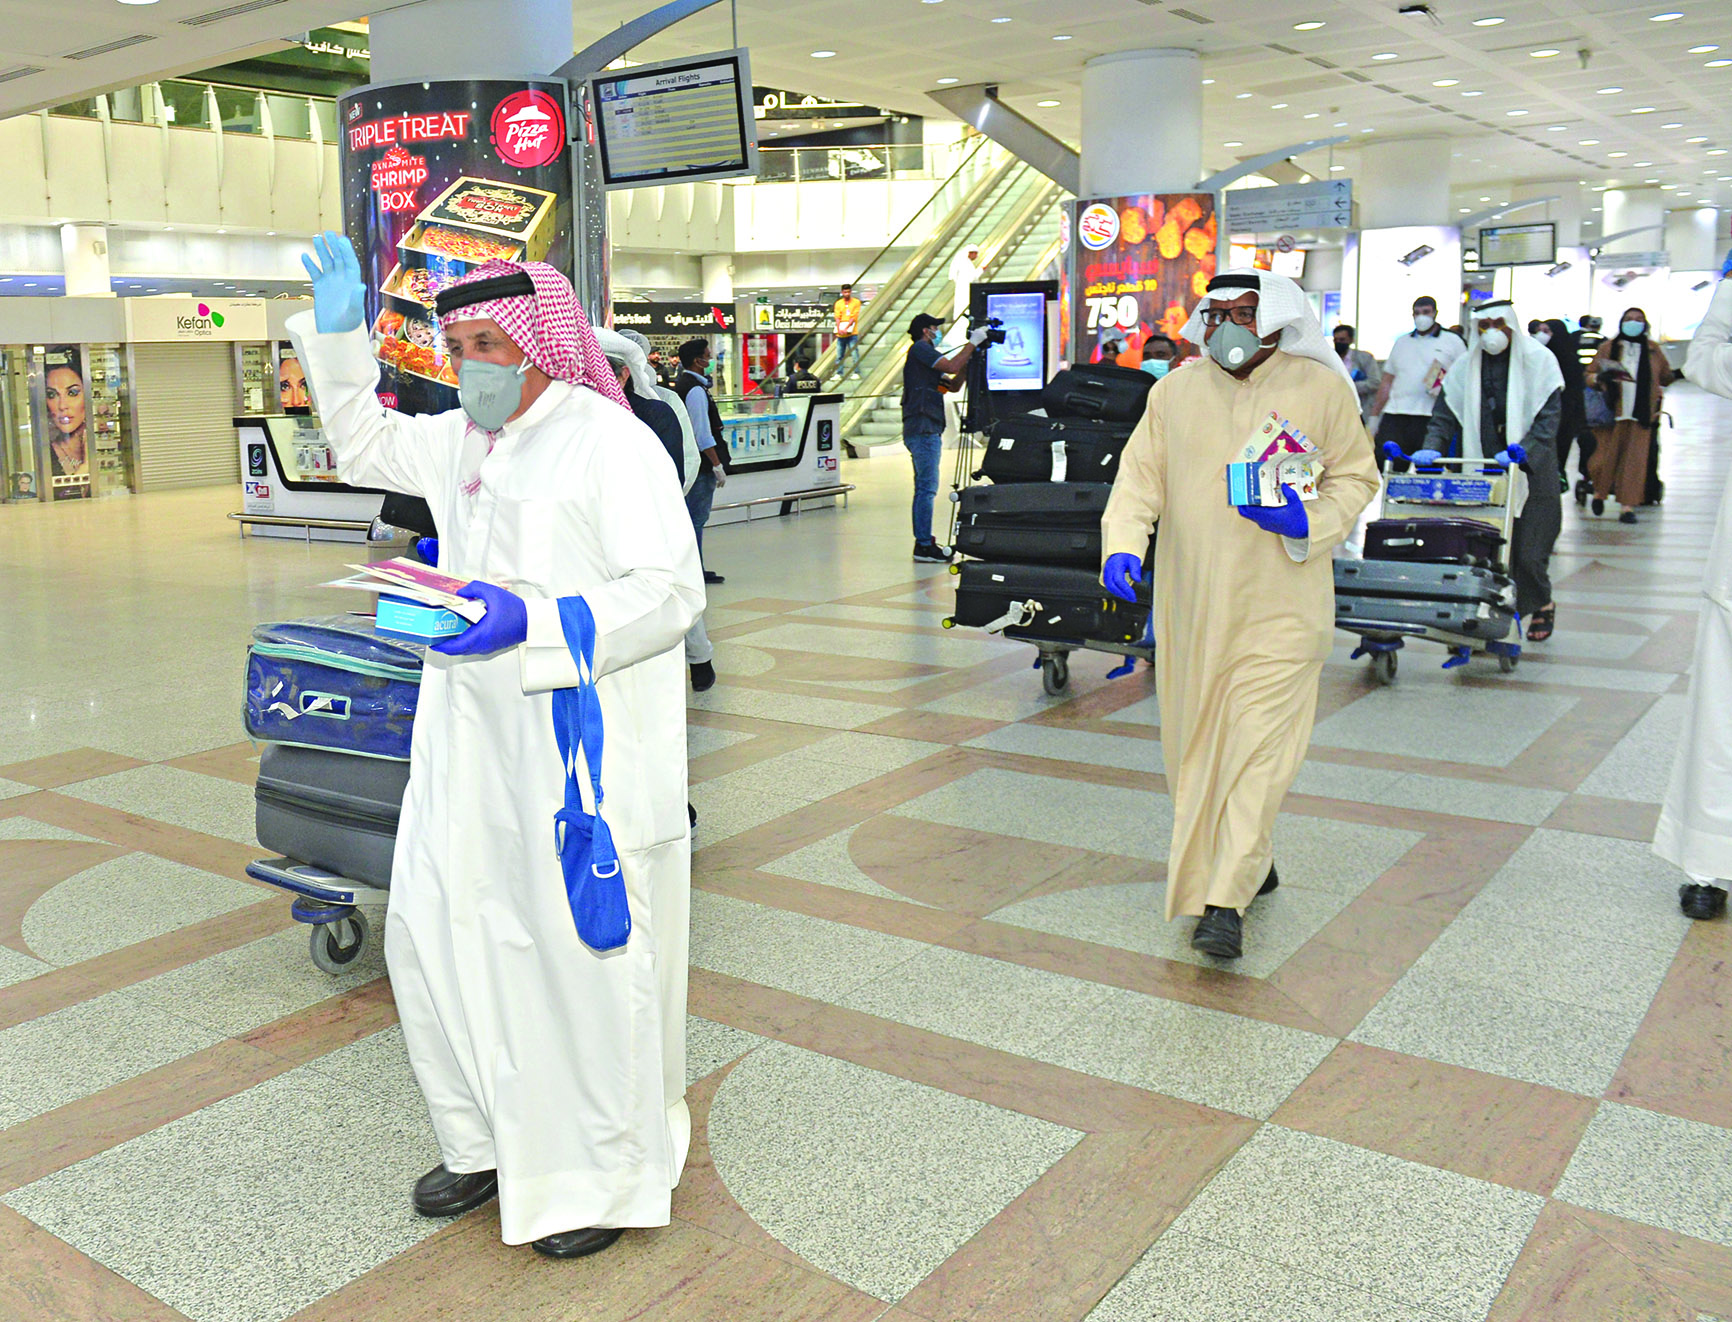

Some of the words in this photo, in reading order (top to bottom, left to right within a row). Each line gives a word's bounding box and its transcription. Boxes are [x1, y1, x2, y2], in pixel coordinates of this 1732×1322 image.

[656, 76, 677, 86] Arrival
[678, 73, 701, 83] Flights
[349, 121, 395, 150] TRIPLE
[398, 114, 468, 140] TREAT
[505, 121, 549, 143] Pizza
[514, 136, 547, 154] Hut
[372, 168, 427, 188] SHRIMP
[381, 190, 416, 211] BOX
[1085, 295, 1138, 328] 750
[177, 316, 212, 329] Kefan
[613, 313, 634, 324] lete's
[775, 319, 791, 329] Oasis
[797, 380, 817, 389] POLICE
[379, 396, 396, 406] OW
[434, 619, 458, 631] acura
